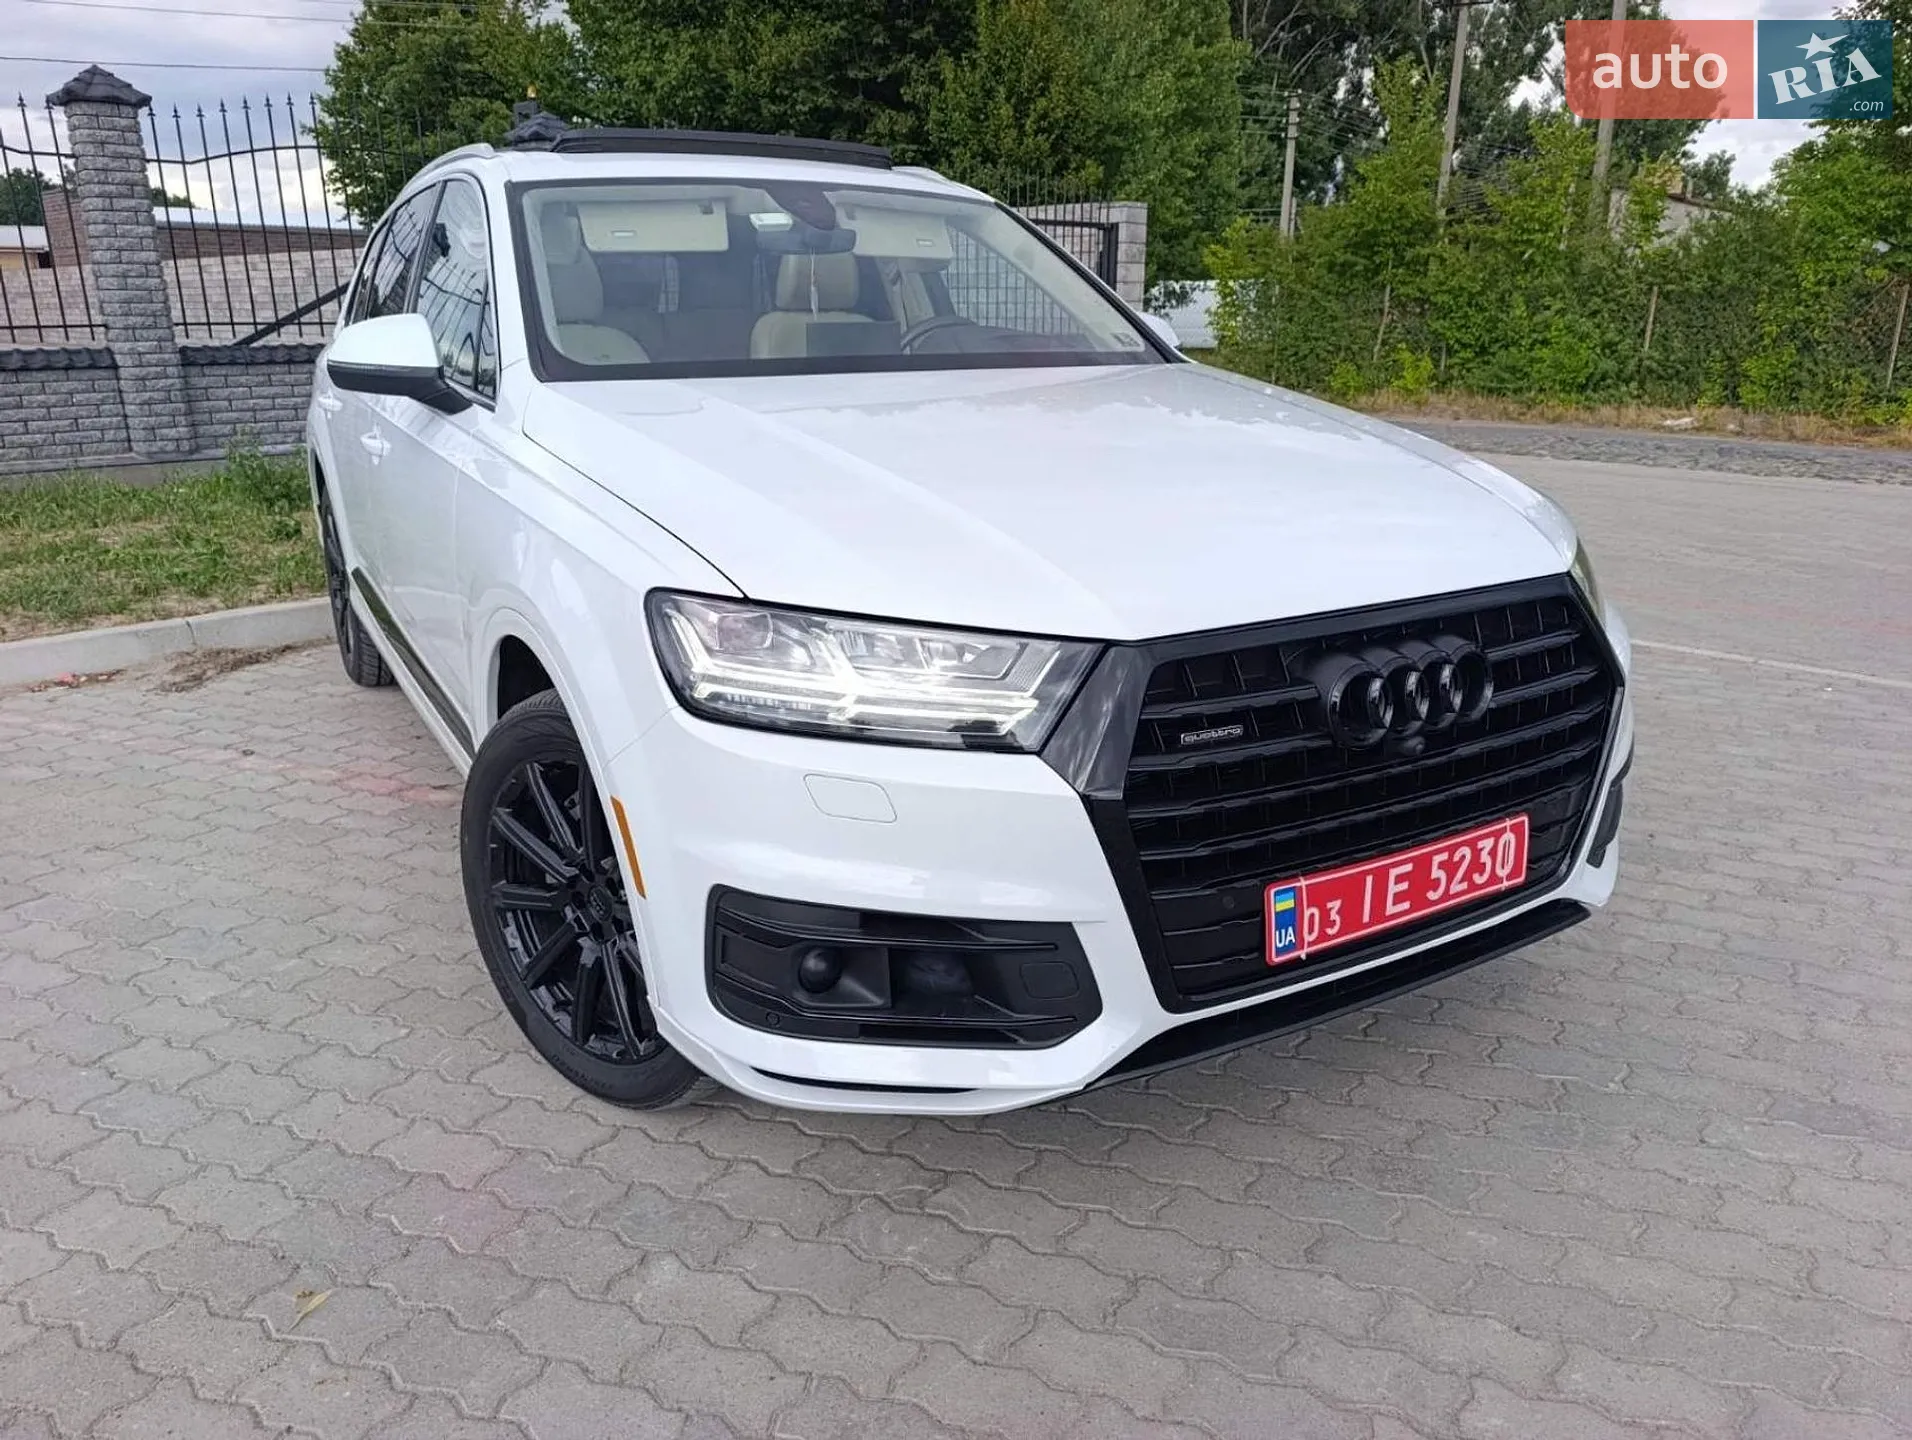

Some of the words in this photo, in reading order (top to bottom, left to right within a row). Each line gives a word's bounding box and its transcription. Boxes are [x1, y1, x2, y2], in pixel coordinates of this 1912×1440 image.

[1183, 727, 1242, 743] quattro
[1303, 899, 1342, 942] 03
[1362, 863, 1413, 923] IE
[1426, 831, 1516, 900] 5230
[1275, 927, 1296, 948] UA
